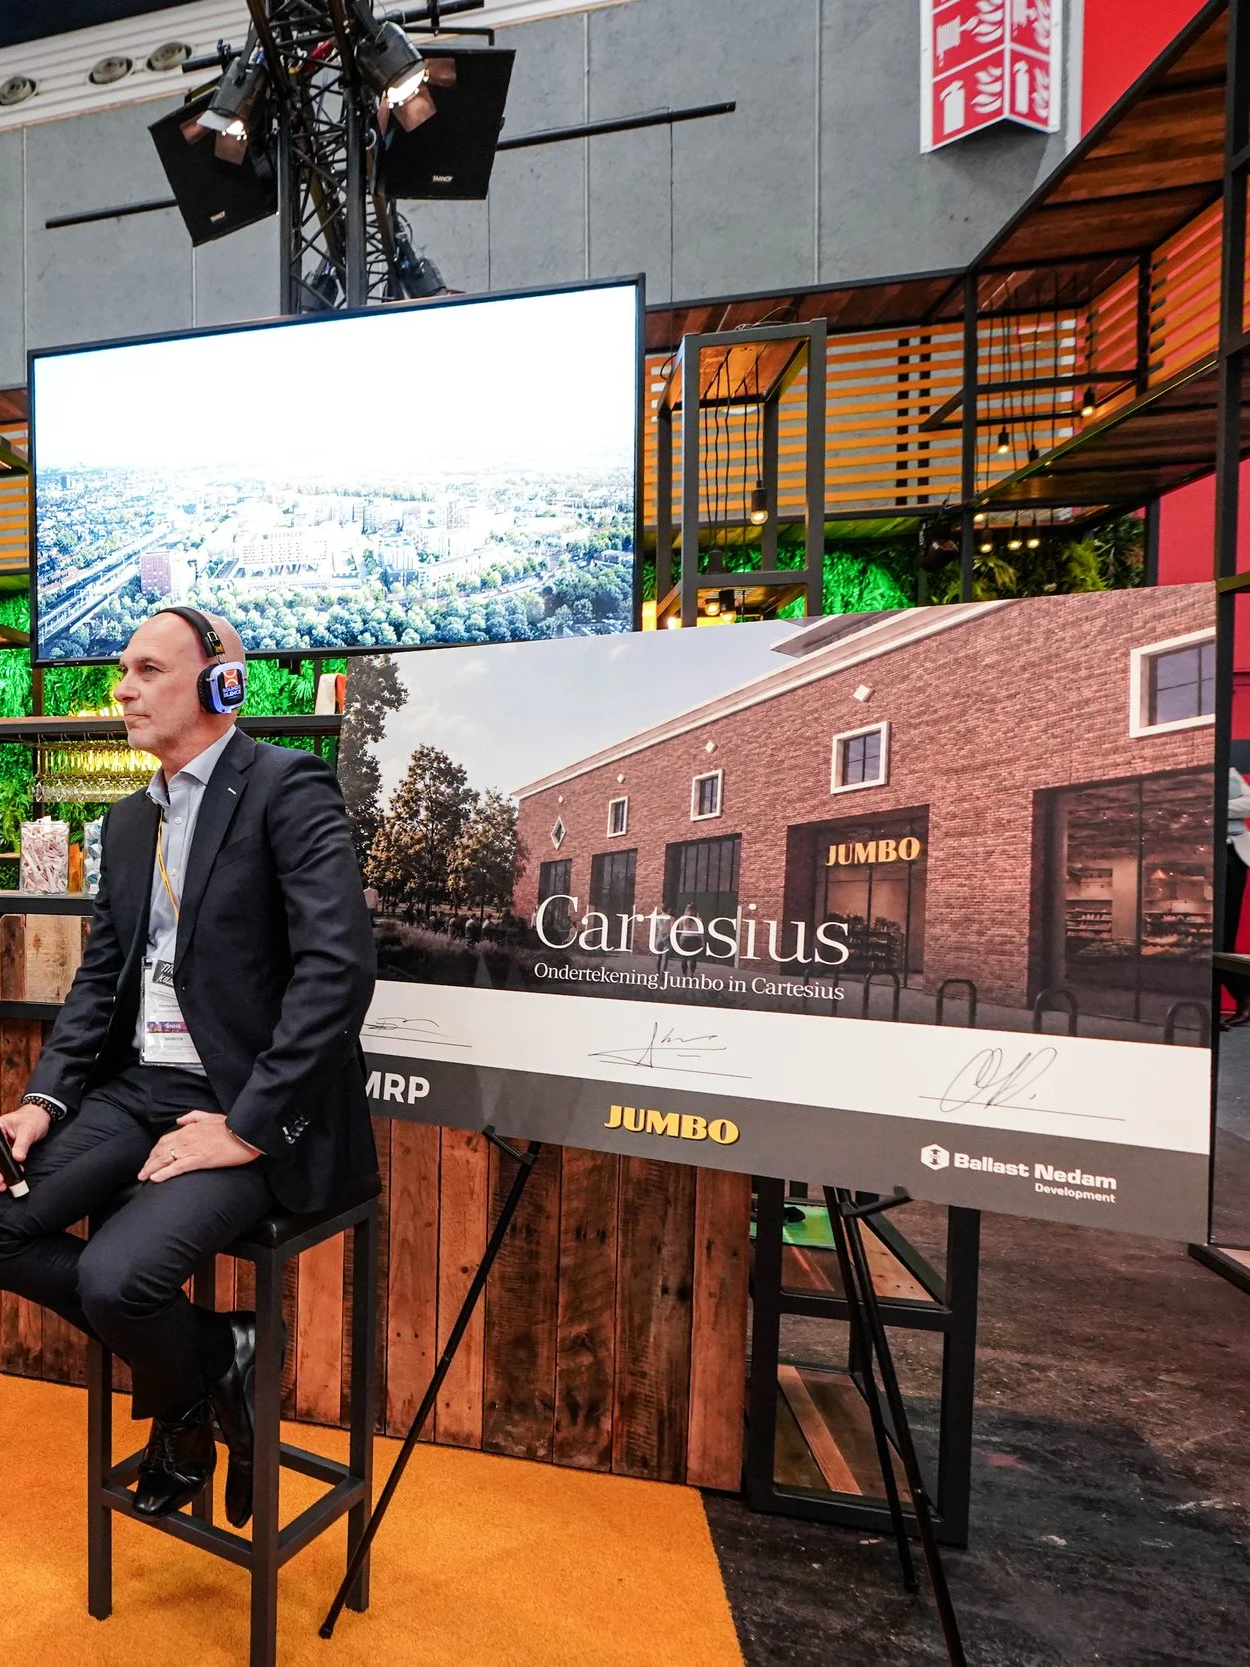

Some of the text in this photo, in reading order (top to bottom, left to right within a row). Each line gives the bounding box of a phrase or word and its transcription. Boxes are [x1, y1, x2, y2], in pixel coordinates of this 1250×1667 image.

[825, 836, 921, 866] JUMBO
[535, 894, 850, 966] Cartesius
[534, 961, 845, 1001] Ondertekening Jumbo in Cartesius
[365, 1070, 430, 1104] MRP
[604, 1105, 740, 1145] JUMBO
[954, 1152, 1117, 1190] Ballast Nedam
[1035, 1182, 1116, 1203] Development
